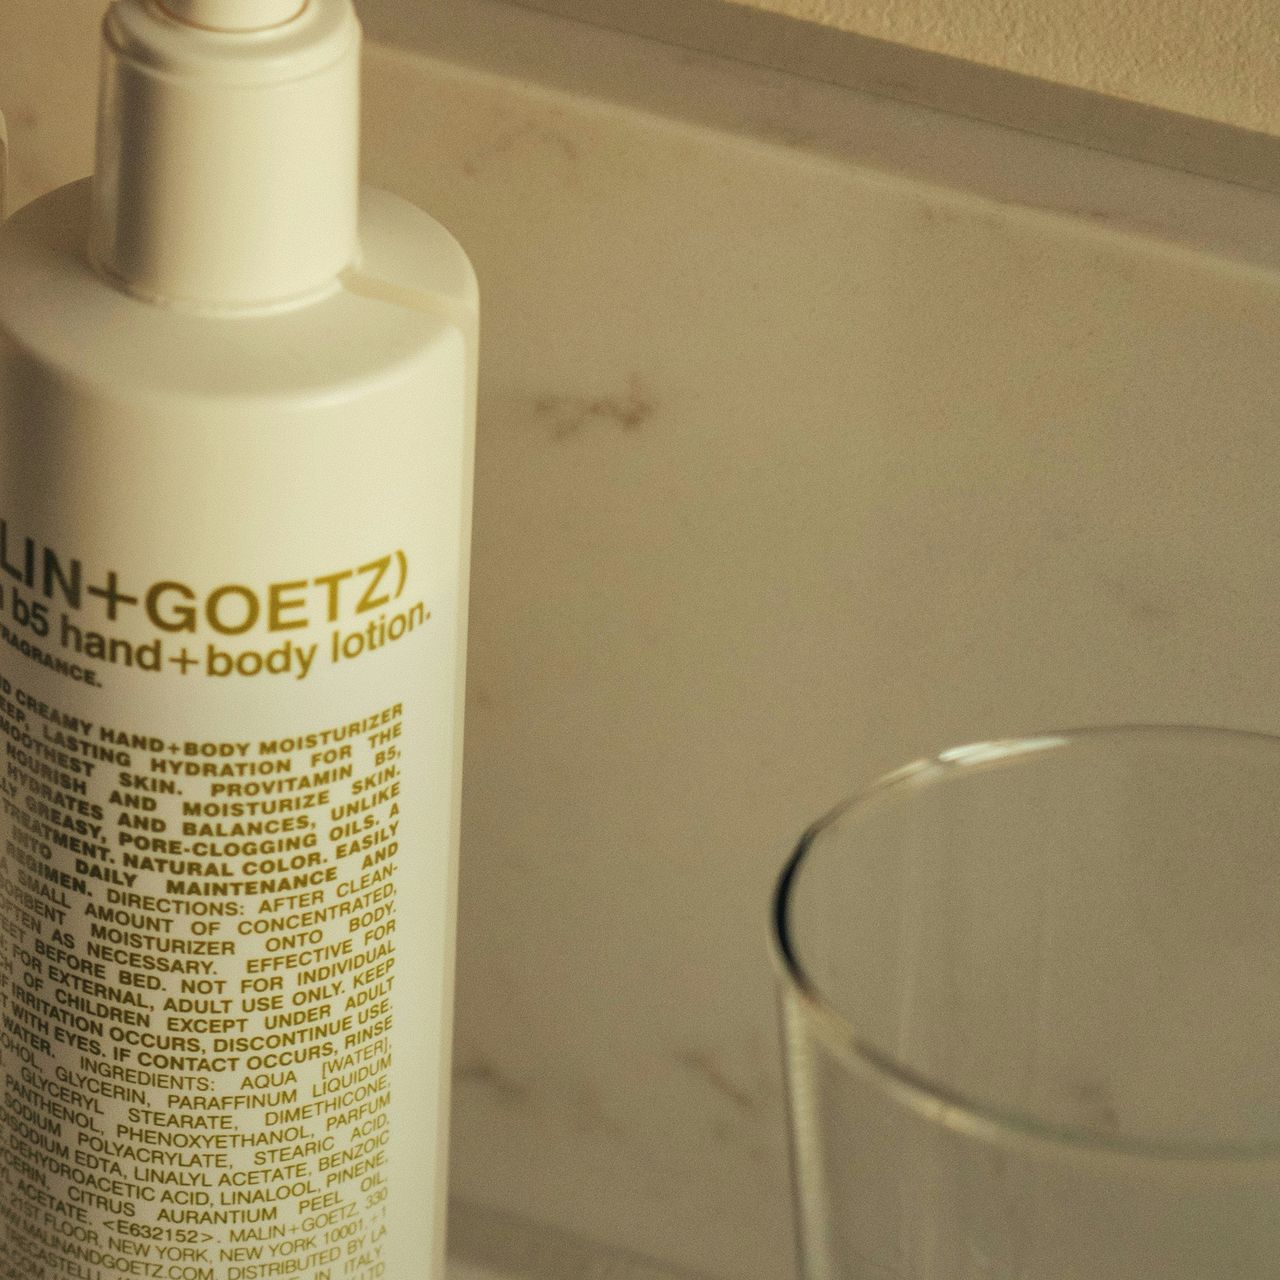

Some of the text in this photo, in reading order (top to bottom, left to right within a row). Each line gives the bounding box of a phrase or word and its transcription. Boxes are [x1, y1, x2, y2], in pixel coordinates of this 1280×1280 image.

[12, 586, 432, 680] b5 hand+body lotion.
[14, 687, 402, 757] CREAMY HAND+BODY MOISTURIZER
[42, 722, 402, 777] LASTING HYDRATION FOR THE
[6, 742, 86, 796] NOURISH
[108, 790, 156, 813] AND
[182, 789, 330, 817] MOISTURIZE
[352, 762, 402, 796] SKIN.
[6, 762, 104, 821] HYDRATES
[116, 811, 166, 834] AND
[182, 812, 316, 837] BALANCES,
[330, 781, 402, 822] UNLIKE
[118, 772, 184, 796] SKIN.
[210, 762, 354, 797] PROVITAMIN
[2, 798, 116, 864] TREATMENT.
[122, 853, 234, 877] NATURAL
[242, 849, 328, 876] COLOR.
[334, 821, 400, 860] EASILY
[118, 801, 400, 857] PORE-CLOGGING OILS. A
[6, 840, 398, 916] REGIMEN. DIRECTIONS: AFTER CLEAN-
[74, 840, 398, 896] DAILY MAINTENANCE AND
[18, 869, 222, 936] SMALL AMOUNT OF
[90, 899, 398, 955] MOISTURIZER ONTO BODY.
[34, 937, 396, 994] BEFORE BED. NOT FOR INDIVIDUAL
[52, 918, 396, 975] AS NECESSARY. EFFECTIVE FOR
[24, 970, 396, 1033] OF CHILDREN EXCEPT UNDER ADULT
[48, 957, 396, 1014] EXTERNAL, ADULT USE ONLY. KEEP
[10, 1000, 392, 1072] WITH EYES. IF CONTACT RINSE
[12, 981, 352, 1057] IRRITATION OCCURS, DISCONTINUE
[2, 1013, 298, 1091] WATER. INGREDIENTS: AQUA
[54, 1053, 392, 1110] GLYCERIN, PARAFFINUM LIQUIDUM
[6, 1073, 104, 1138] PANTHENOL,
[326, 1091, 392, 1132] PARFUM
[20, 1065, 238, 1133] GLYCERYL STEARATE,
[4, 1092, 62, 1138] SODIUM
[78, 1132, 234, 1171] POLYACRYLATE,
[254, 1135, 336, 1166] STEARIC
[134, 1128, 390, 1187] LINALYL BENZOIC
[10, 1134, 214, 1210] DEHYDROACETIC ACID,
[68, 1185, 344, 1225] CITRUS AURANTIUM PEEL
[108, 1234, 318, 1262] NEW NEW YORK
[228, 1234, 366, 1280] DISTRIBUTED BY
